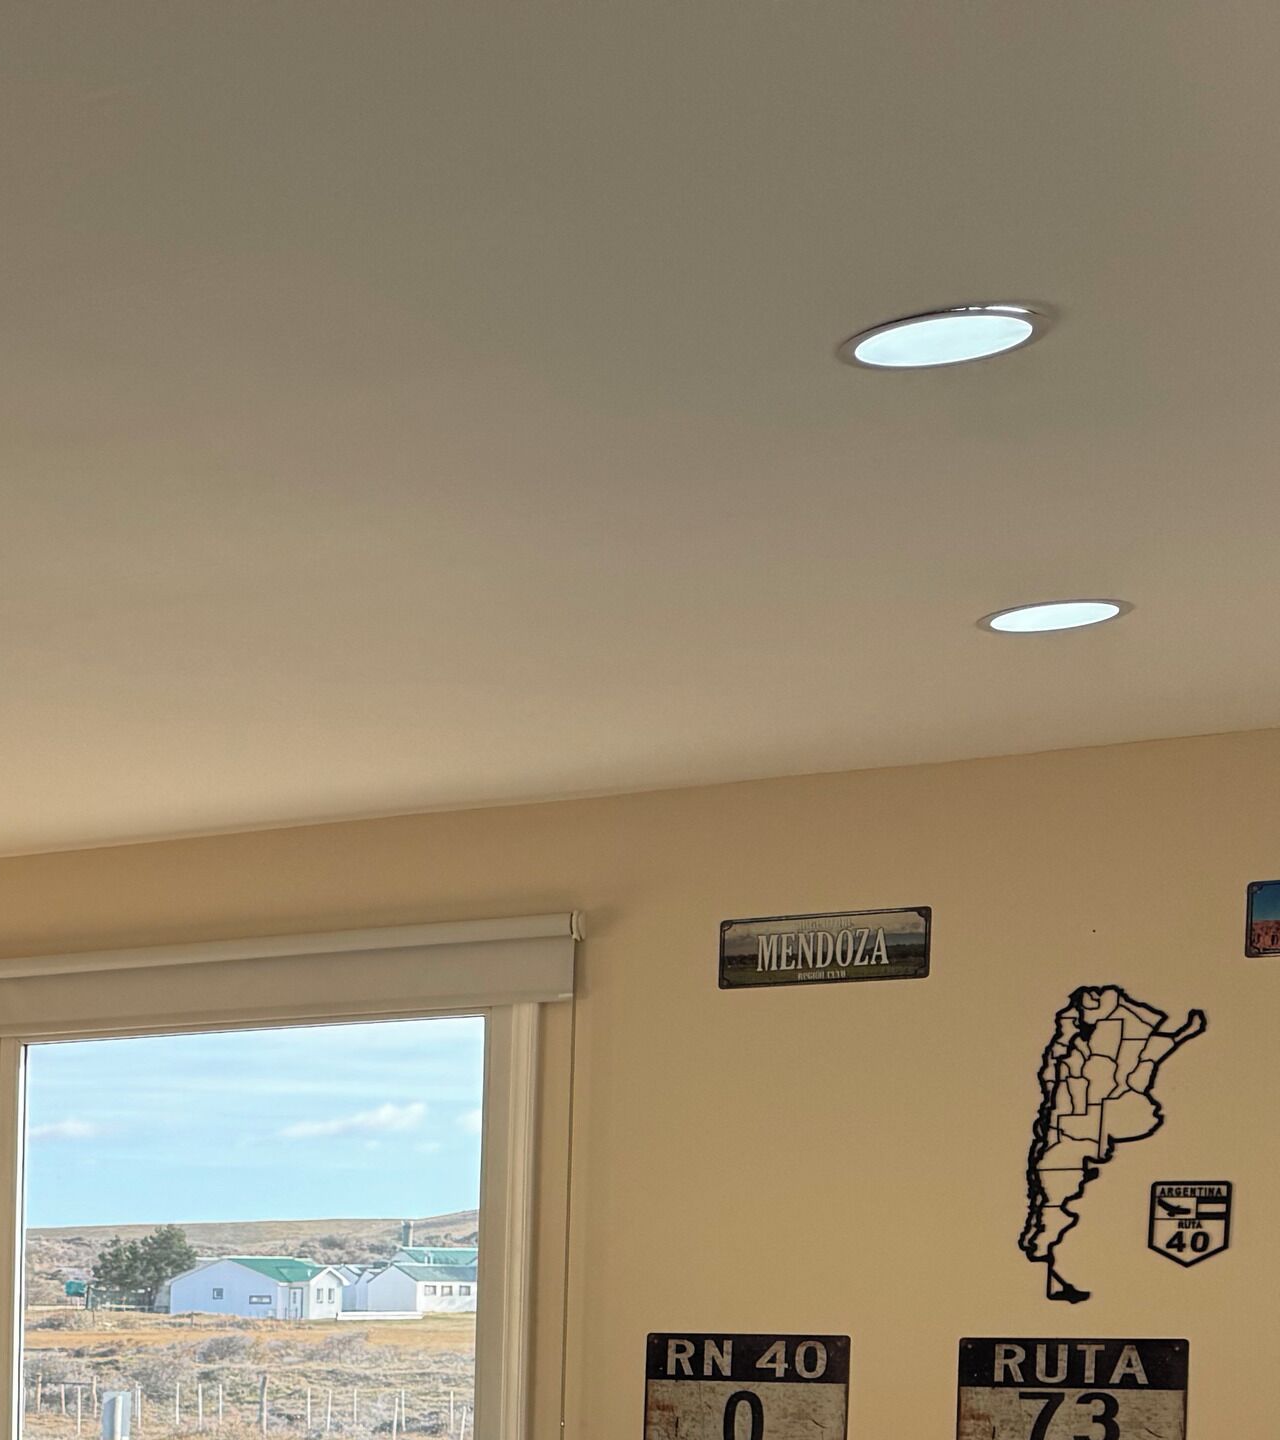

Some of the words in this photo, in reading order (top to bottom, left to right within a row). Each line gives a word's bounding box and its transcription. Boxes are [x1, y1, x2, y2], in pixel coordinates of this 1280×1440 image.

[756, 927, 890, 972] MENDOZA
[1160, 1187, 1222, 1197] ARGENTINA
[1178, 1220, 1203, 1229] RUTA
[1166, 1230, 1210, 1253] 40
[666, 1338, 733, 1377] RN
[755, 1340, 828, 1379] 40
[993, 1343, 1149, 1385] RUTA
